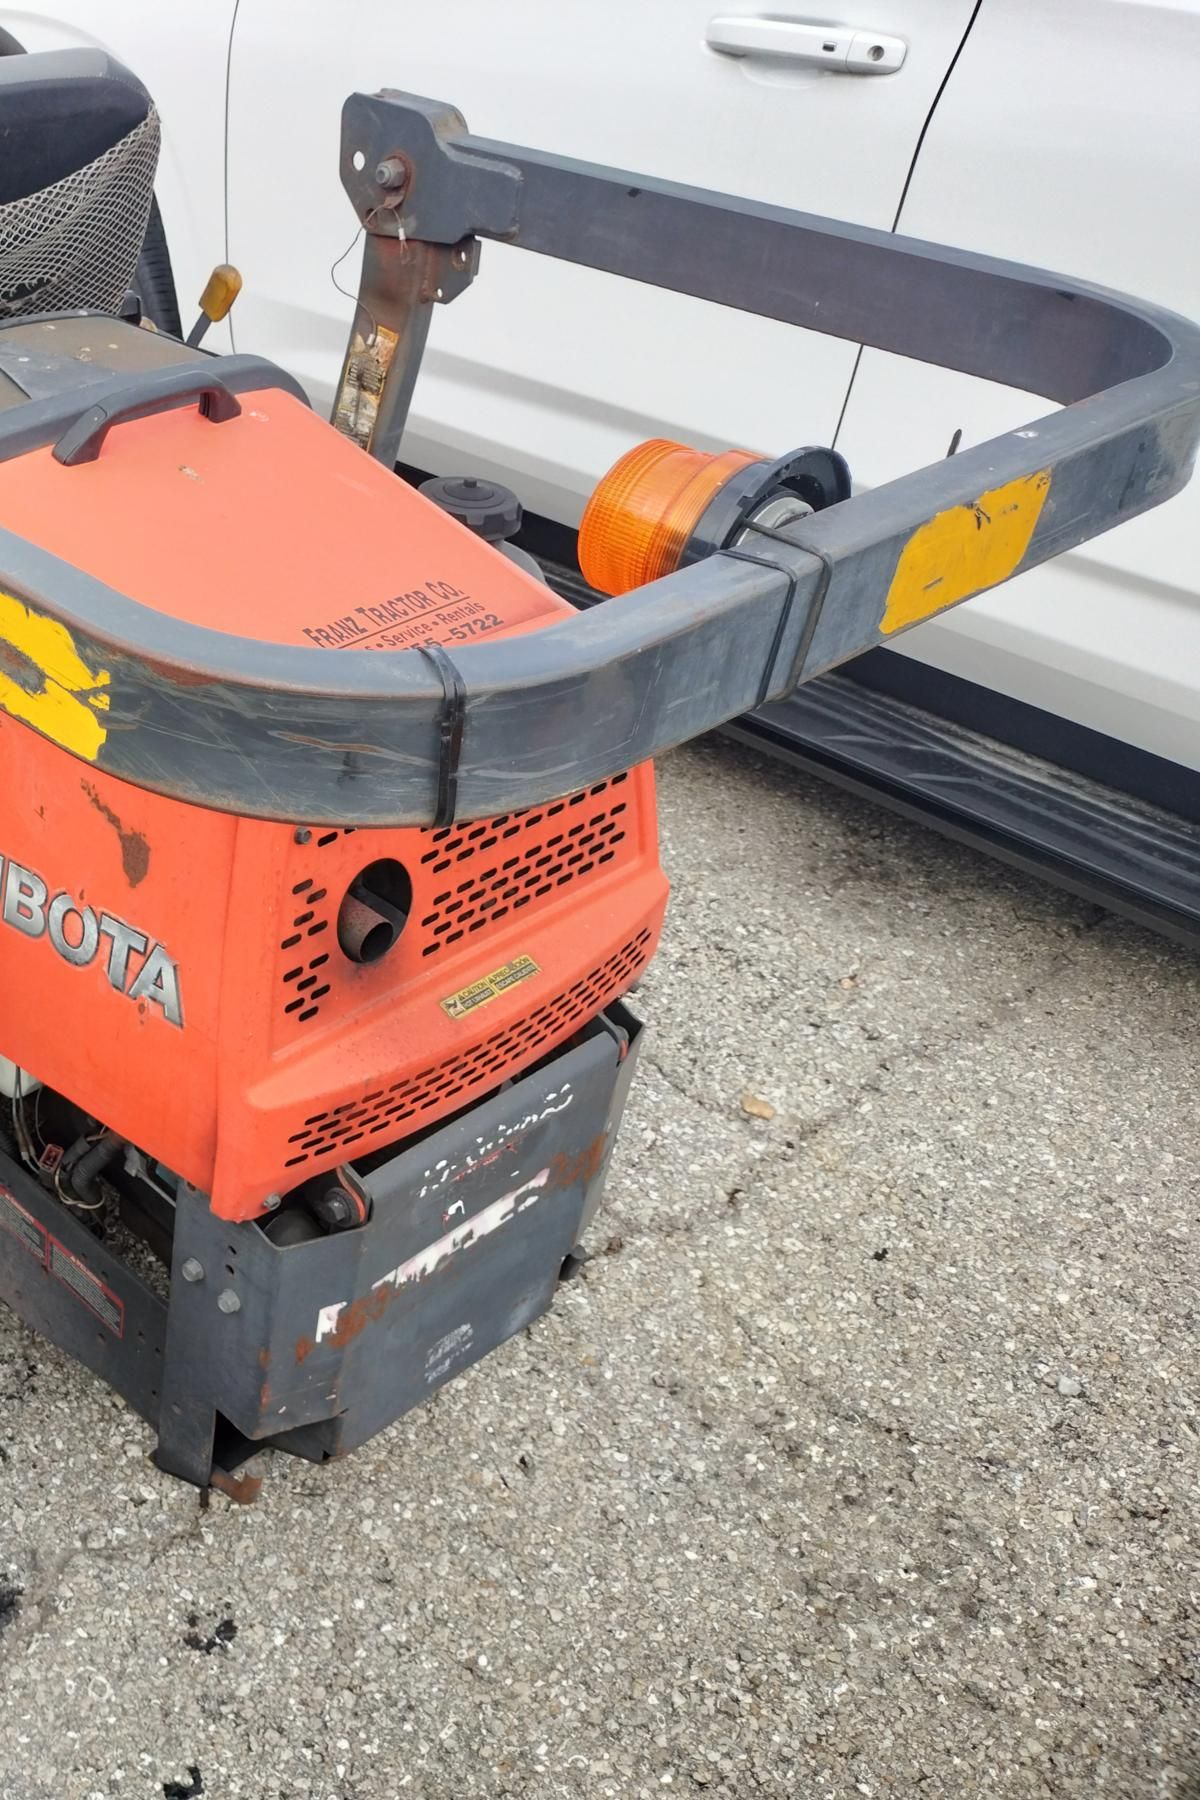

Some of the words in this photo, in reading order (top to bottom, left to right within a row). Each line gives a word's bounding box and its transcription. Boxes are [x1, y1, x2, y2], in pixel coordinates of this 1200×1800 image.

[302, 616, 369, 648] FRANZ
[354, 590, 438, 627] TRACTOR
[381, 620, 434, 646] Service
[435, 601, 486, 626] Rentals
